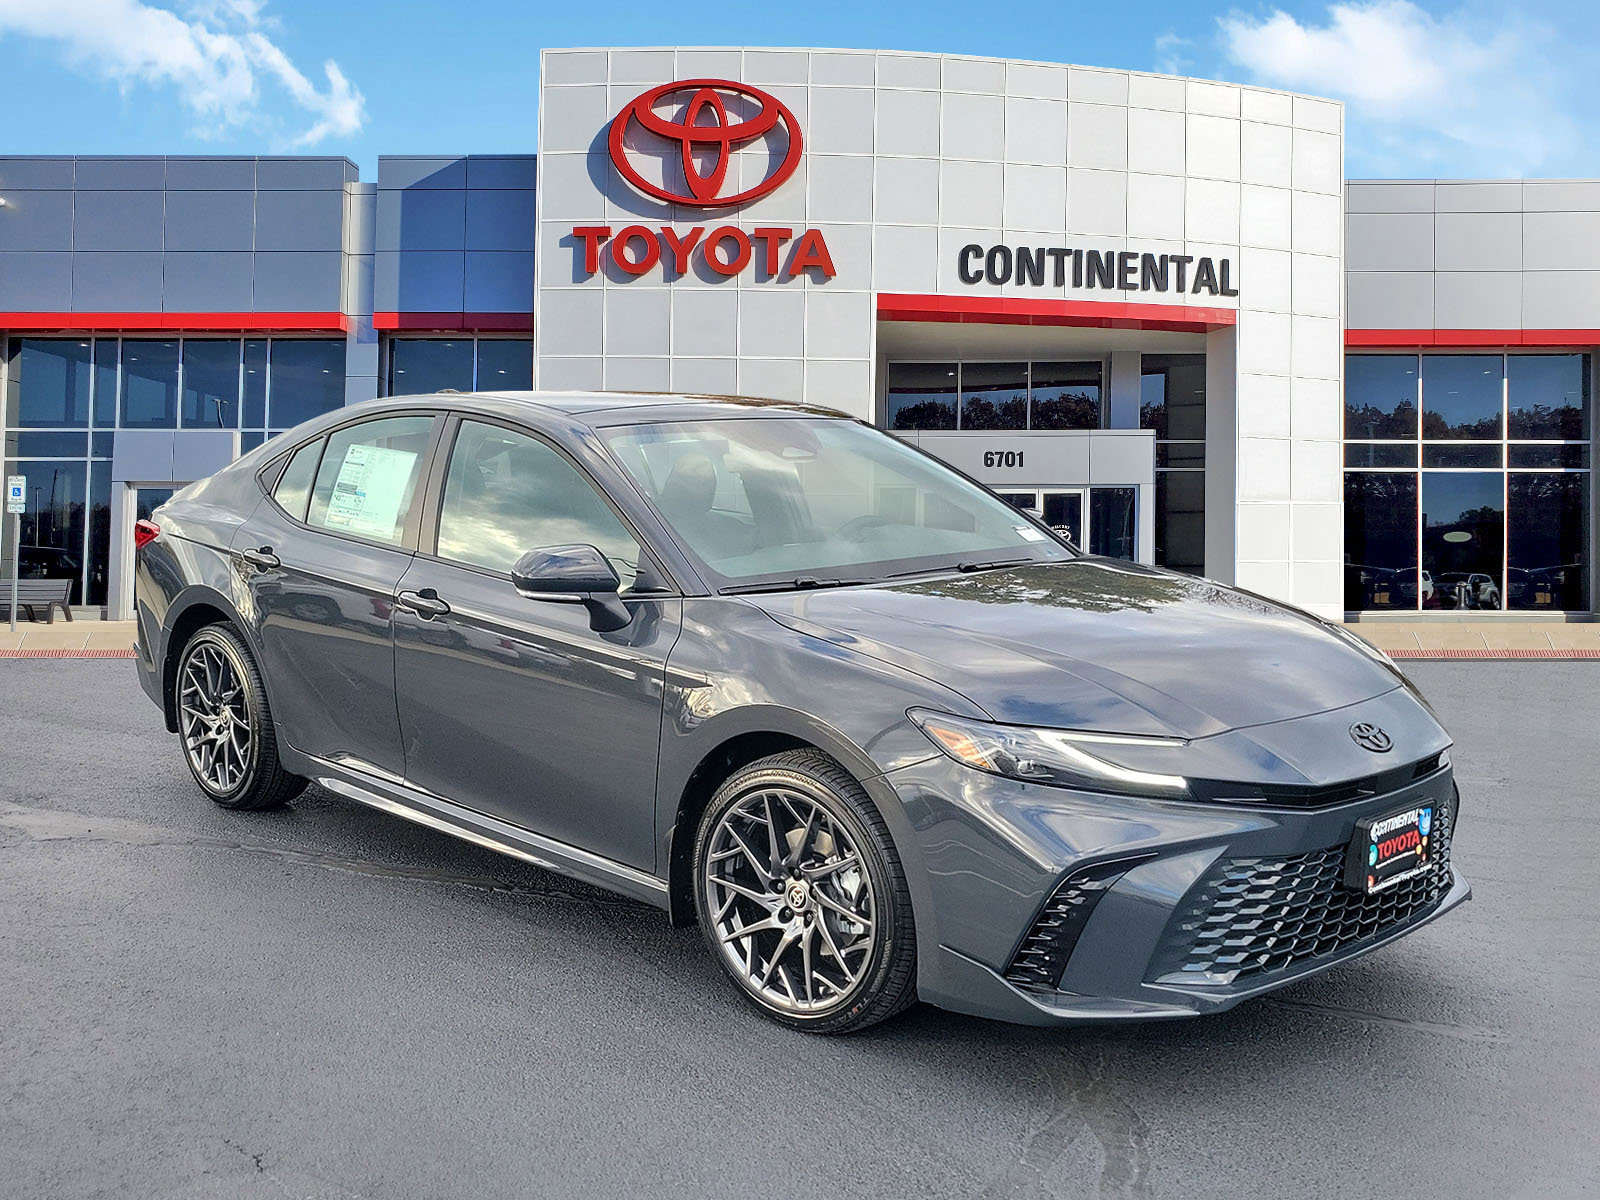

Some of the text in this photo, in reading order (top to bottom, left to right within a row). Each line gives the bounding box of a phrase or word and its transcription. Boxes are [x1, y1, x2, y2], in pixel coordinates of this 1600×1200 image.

[572, 225, 837, 278] TOYOTA
[958, 244, 1239, 297] CONTINENTAL
[983, 451, 1024, 468] 6701
[1370, 808, 1420, 841] CONTINENTAL
[1377, 830, 1420, 860] TOYOTA
